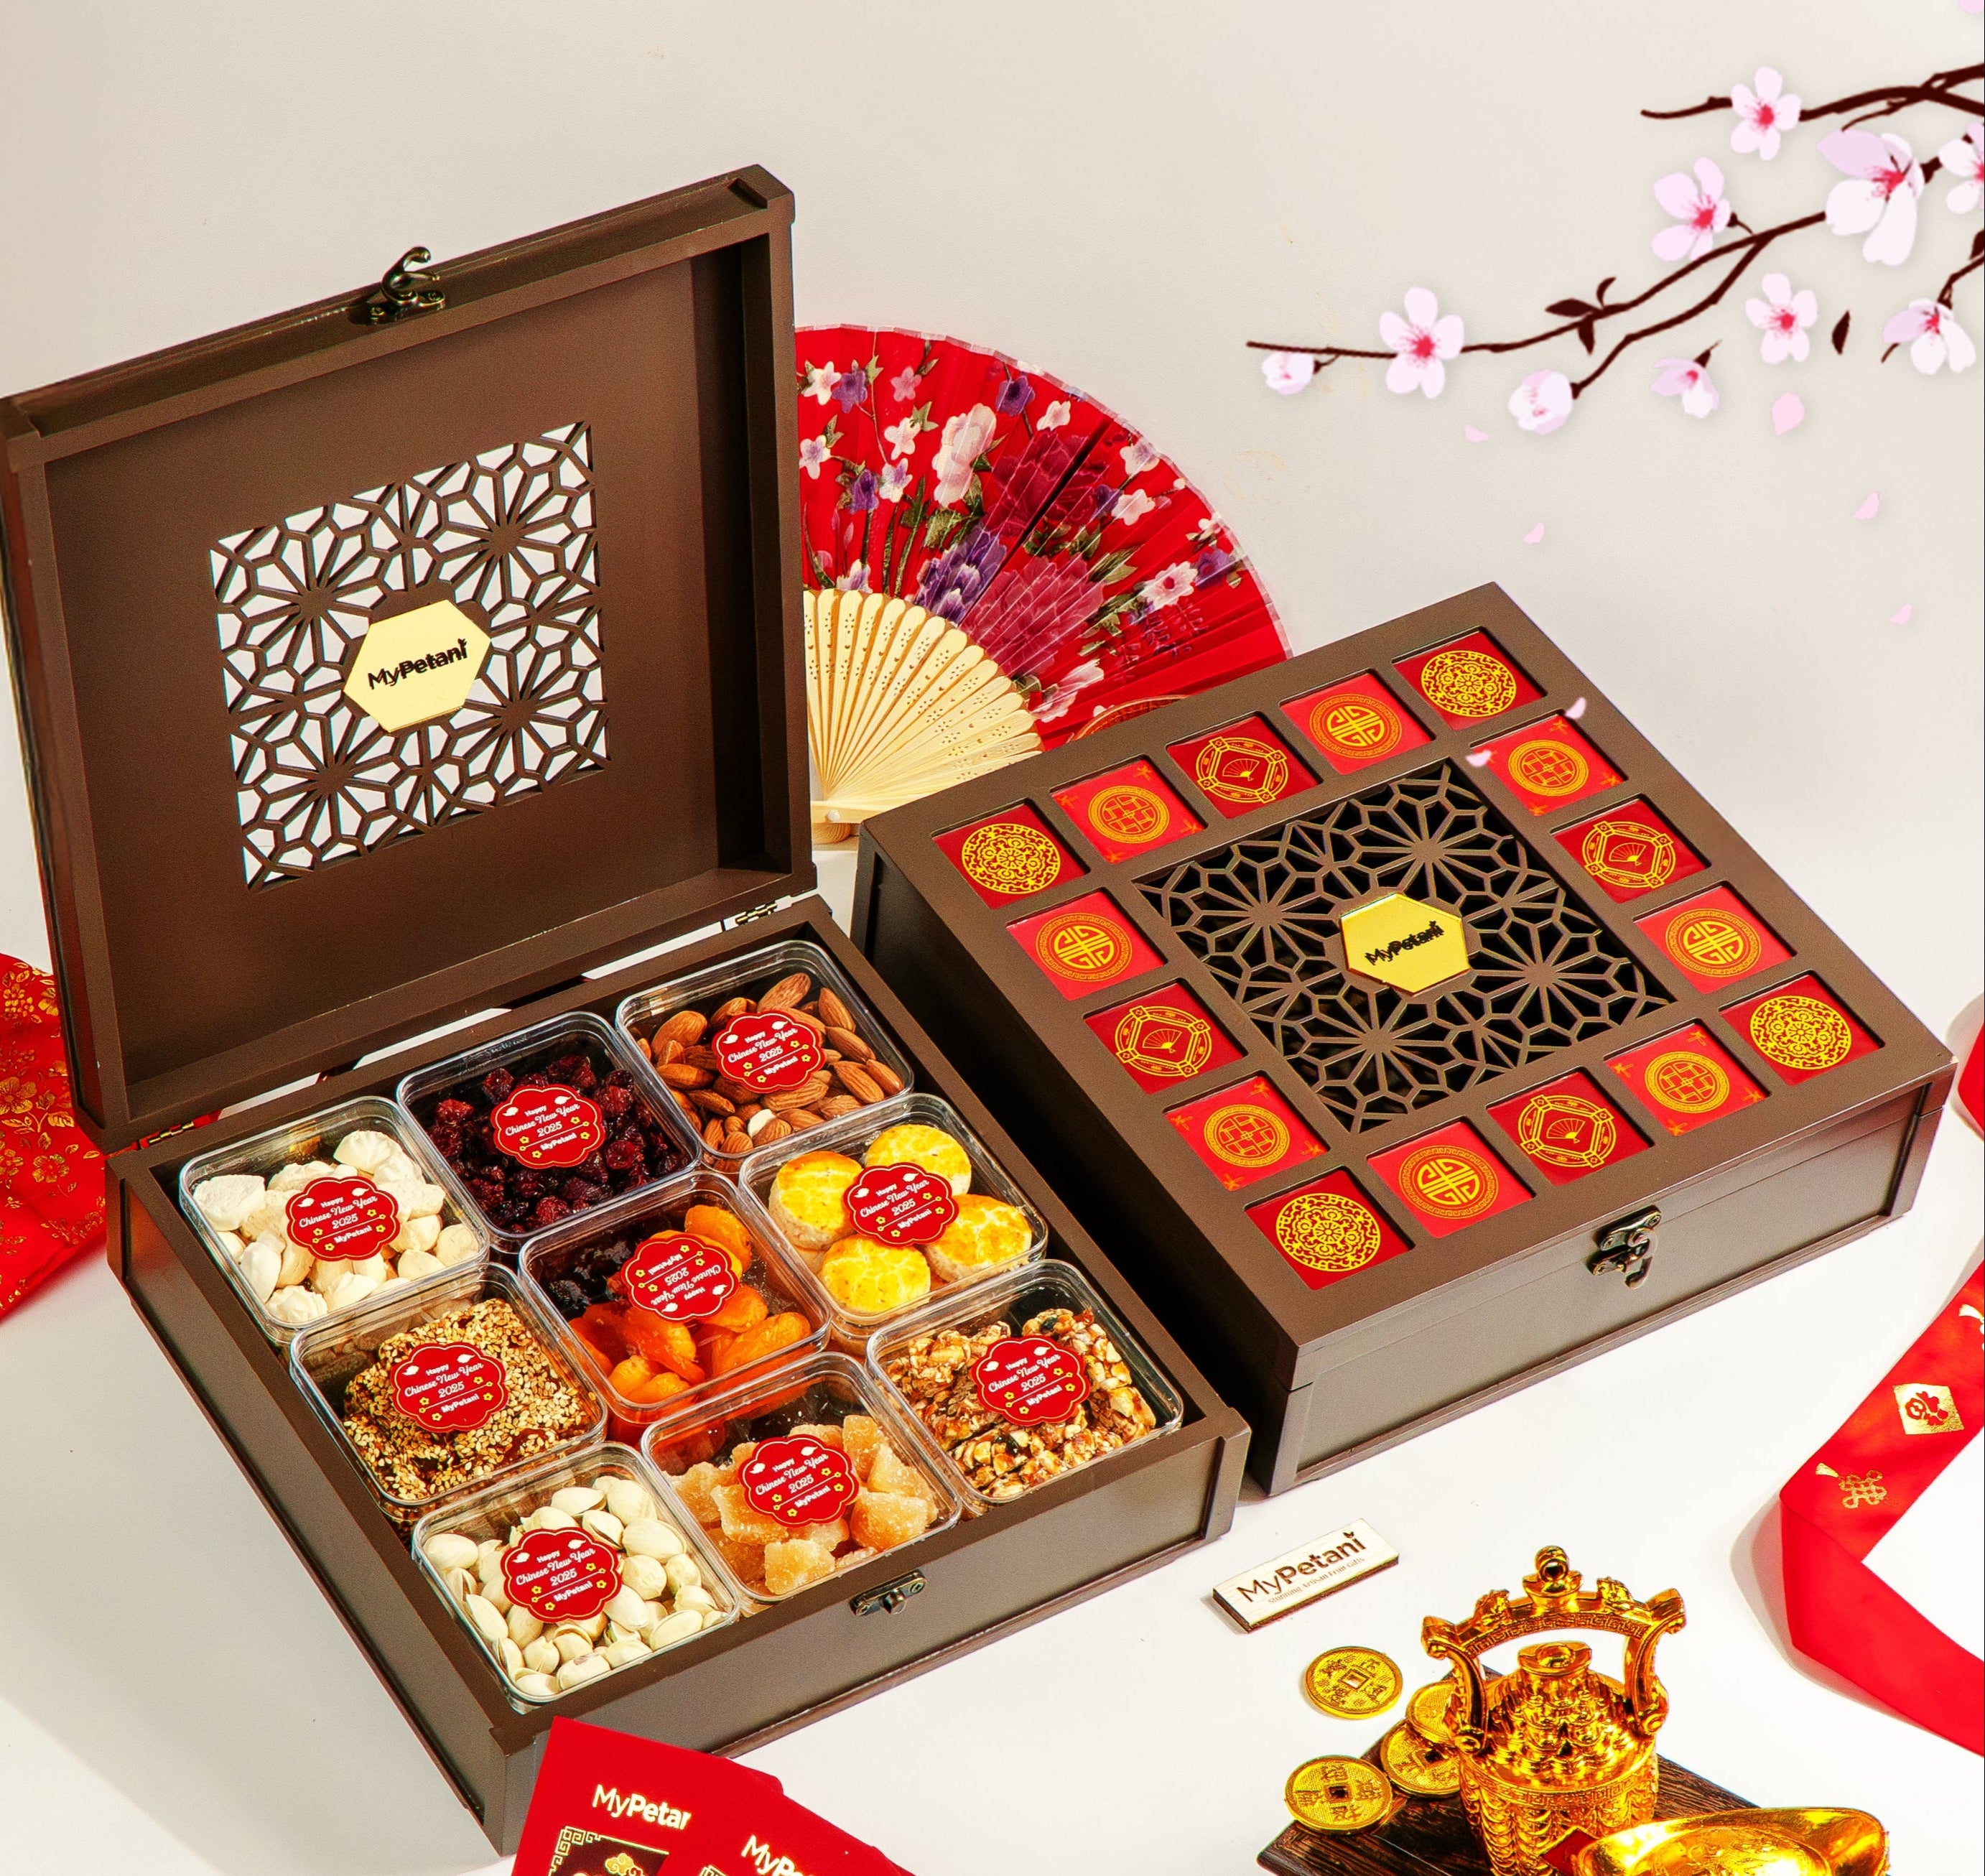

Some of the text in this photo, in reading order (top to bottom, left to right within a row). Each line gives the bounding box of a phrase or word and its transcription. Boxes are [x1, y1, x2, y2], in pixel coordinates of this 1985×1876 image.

[368, 639, 468, 689] MyPetani
[1365, 921, 1444, 965] MyPetani
[727, 1028, 798, 1063] Chinese New Year
[745, 1031, 766, 1043] Happy
[759, 1046, 783, 1063] 2025
[763, 1056, 799, 1074] MyPetani
[505, 1104, 580, 1136] Chinese New Year
[524, 1105, 547, 1116] Happy
[537, 1121, 562, 1137] 2025
[540, 1133, 577, 1151] MyPetani
[860, 1180, 929, 1217] Chinese New Year
[875, 1184, 897, 1196] Happy
[299, 1196, 378, 1227] Chinese New Year
[320, 1197, 343, 1208] Happy
[891, 1198, 916, 1216] 2025
[332, 1214, 358, 1230] 2025
[898, 1209, 932, 1229] MyPetani
[333, 1225, 372, 1243] MyPetani
[648, 1254, 683, 1275] MyPetani
[651, 1265, 721, 1305] Chinese New Year
[664, 1267, 689, 1286] 2025
[684, 1287, 705, 1301] Happy
[426, 1364, 449, 1376] Happy
[1005, 1357, 1028, 1370] Happy
[404, 1363, 483, 1397] Chinese New Year
[988, 1355, 1061, 1393] Chinese New Year
[1021, 1373, 1046, 1392] 2025
[438, 1381, 465, 1398] 2025
[1026, 1385, 1062, 1406] MyPetani
[441, 1393, 480, 1413] MyPetani
[756, 1454, 828, 1495] Chinese New Year
[772, 1458, 794, 1472] Happy
[789, 1474, 814, 1494] 2025
[794, 1485, 831, 1508] MyPetani
[516, 1548, 595, 1585] Chinese New Year
[536, 1551, 560, 1563] Happy
[1237, 1531, 1366, 1602] MyPetani
[550, 1568, 577, 1587] 2025
[554, 1581, 593, 1602] MyPetani
